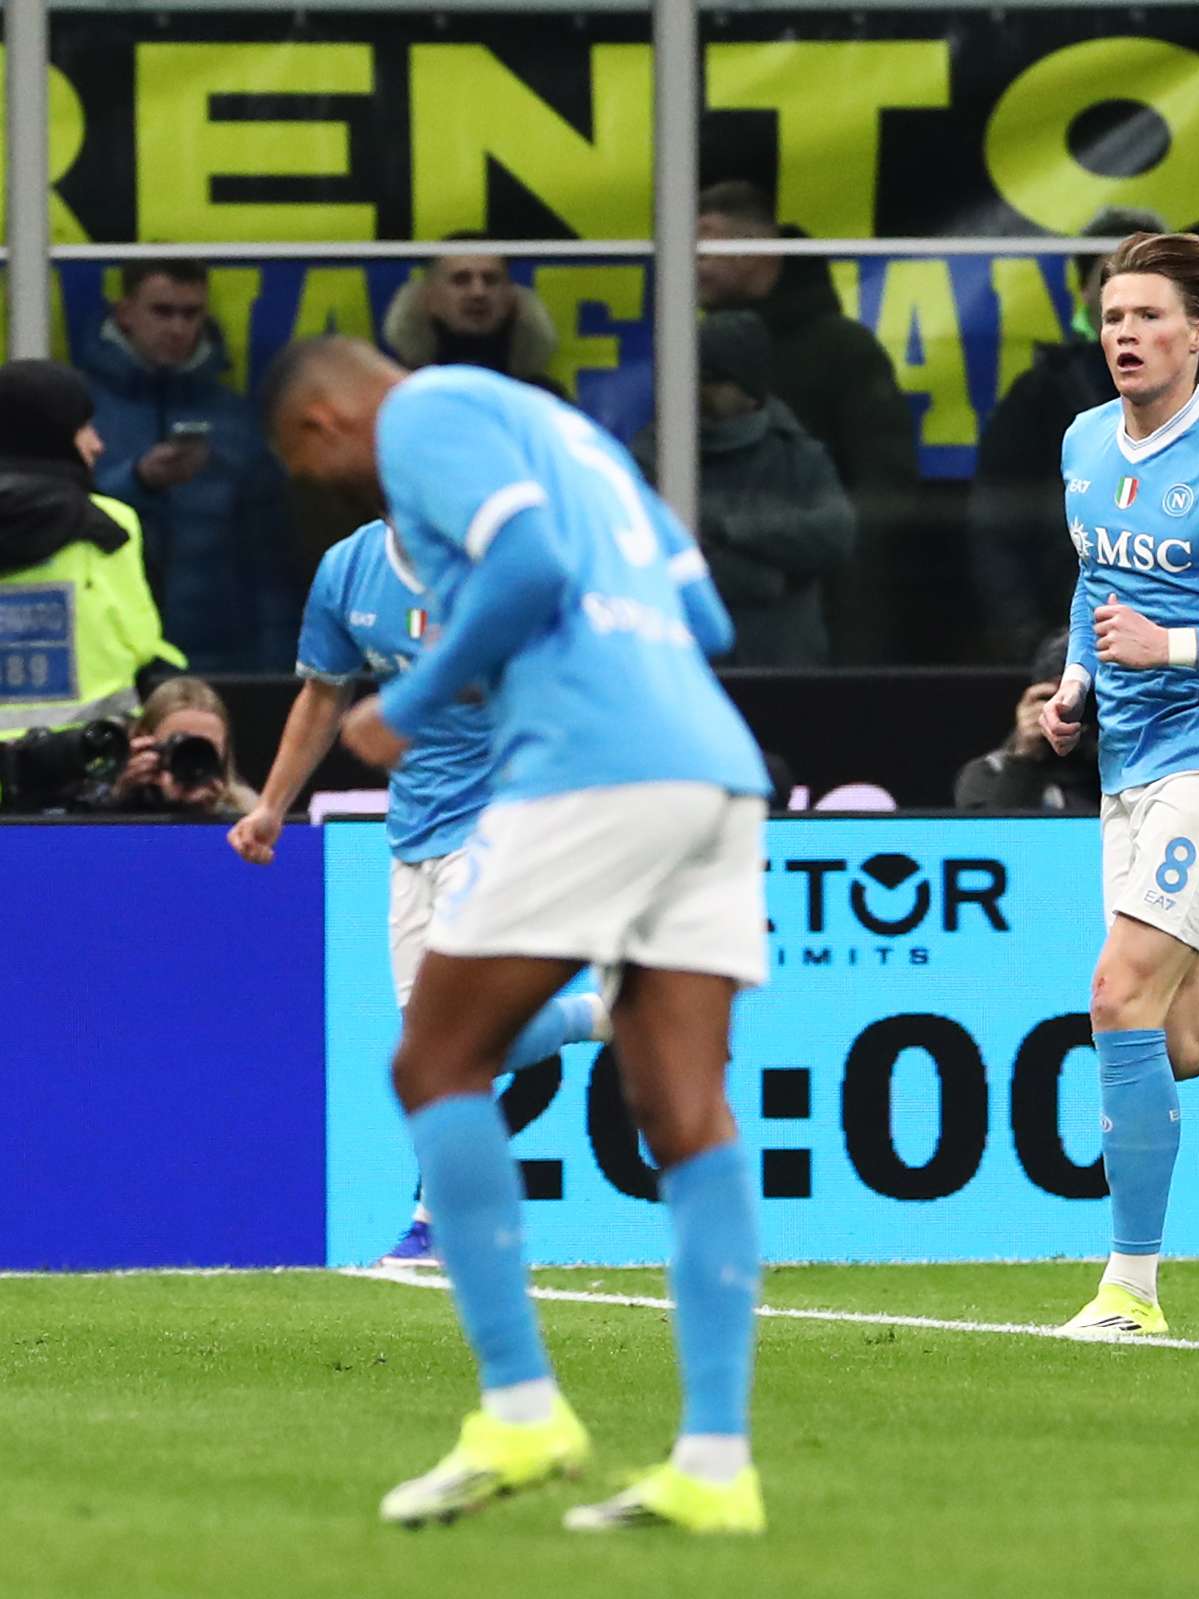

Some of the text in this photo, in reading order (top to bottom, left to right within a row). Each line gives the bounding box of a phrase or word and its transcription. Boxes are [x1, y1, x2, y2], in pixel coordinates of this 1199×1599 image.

[1095, 527, 1193, 573] MSC
[1155, 836, 1197, 894] 8
[764, 853, 1010, 937] TOR
[1143, 889, 1177, 911] EA7
